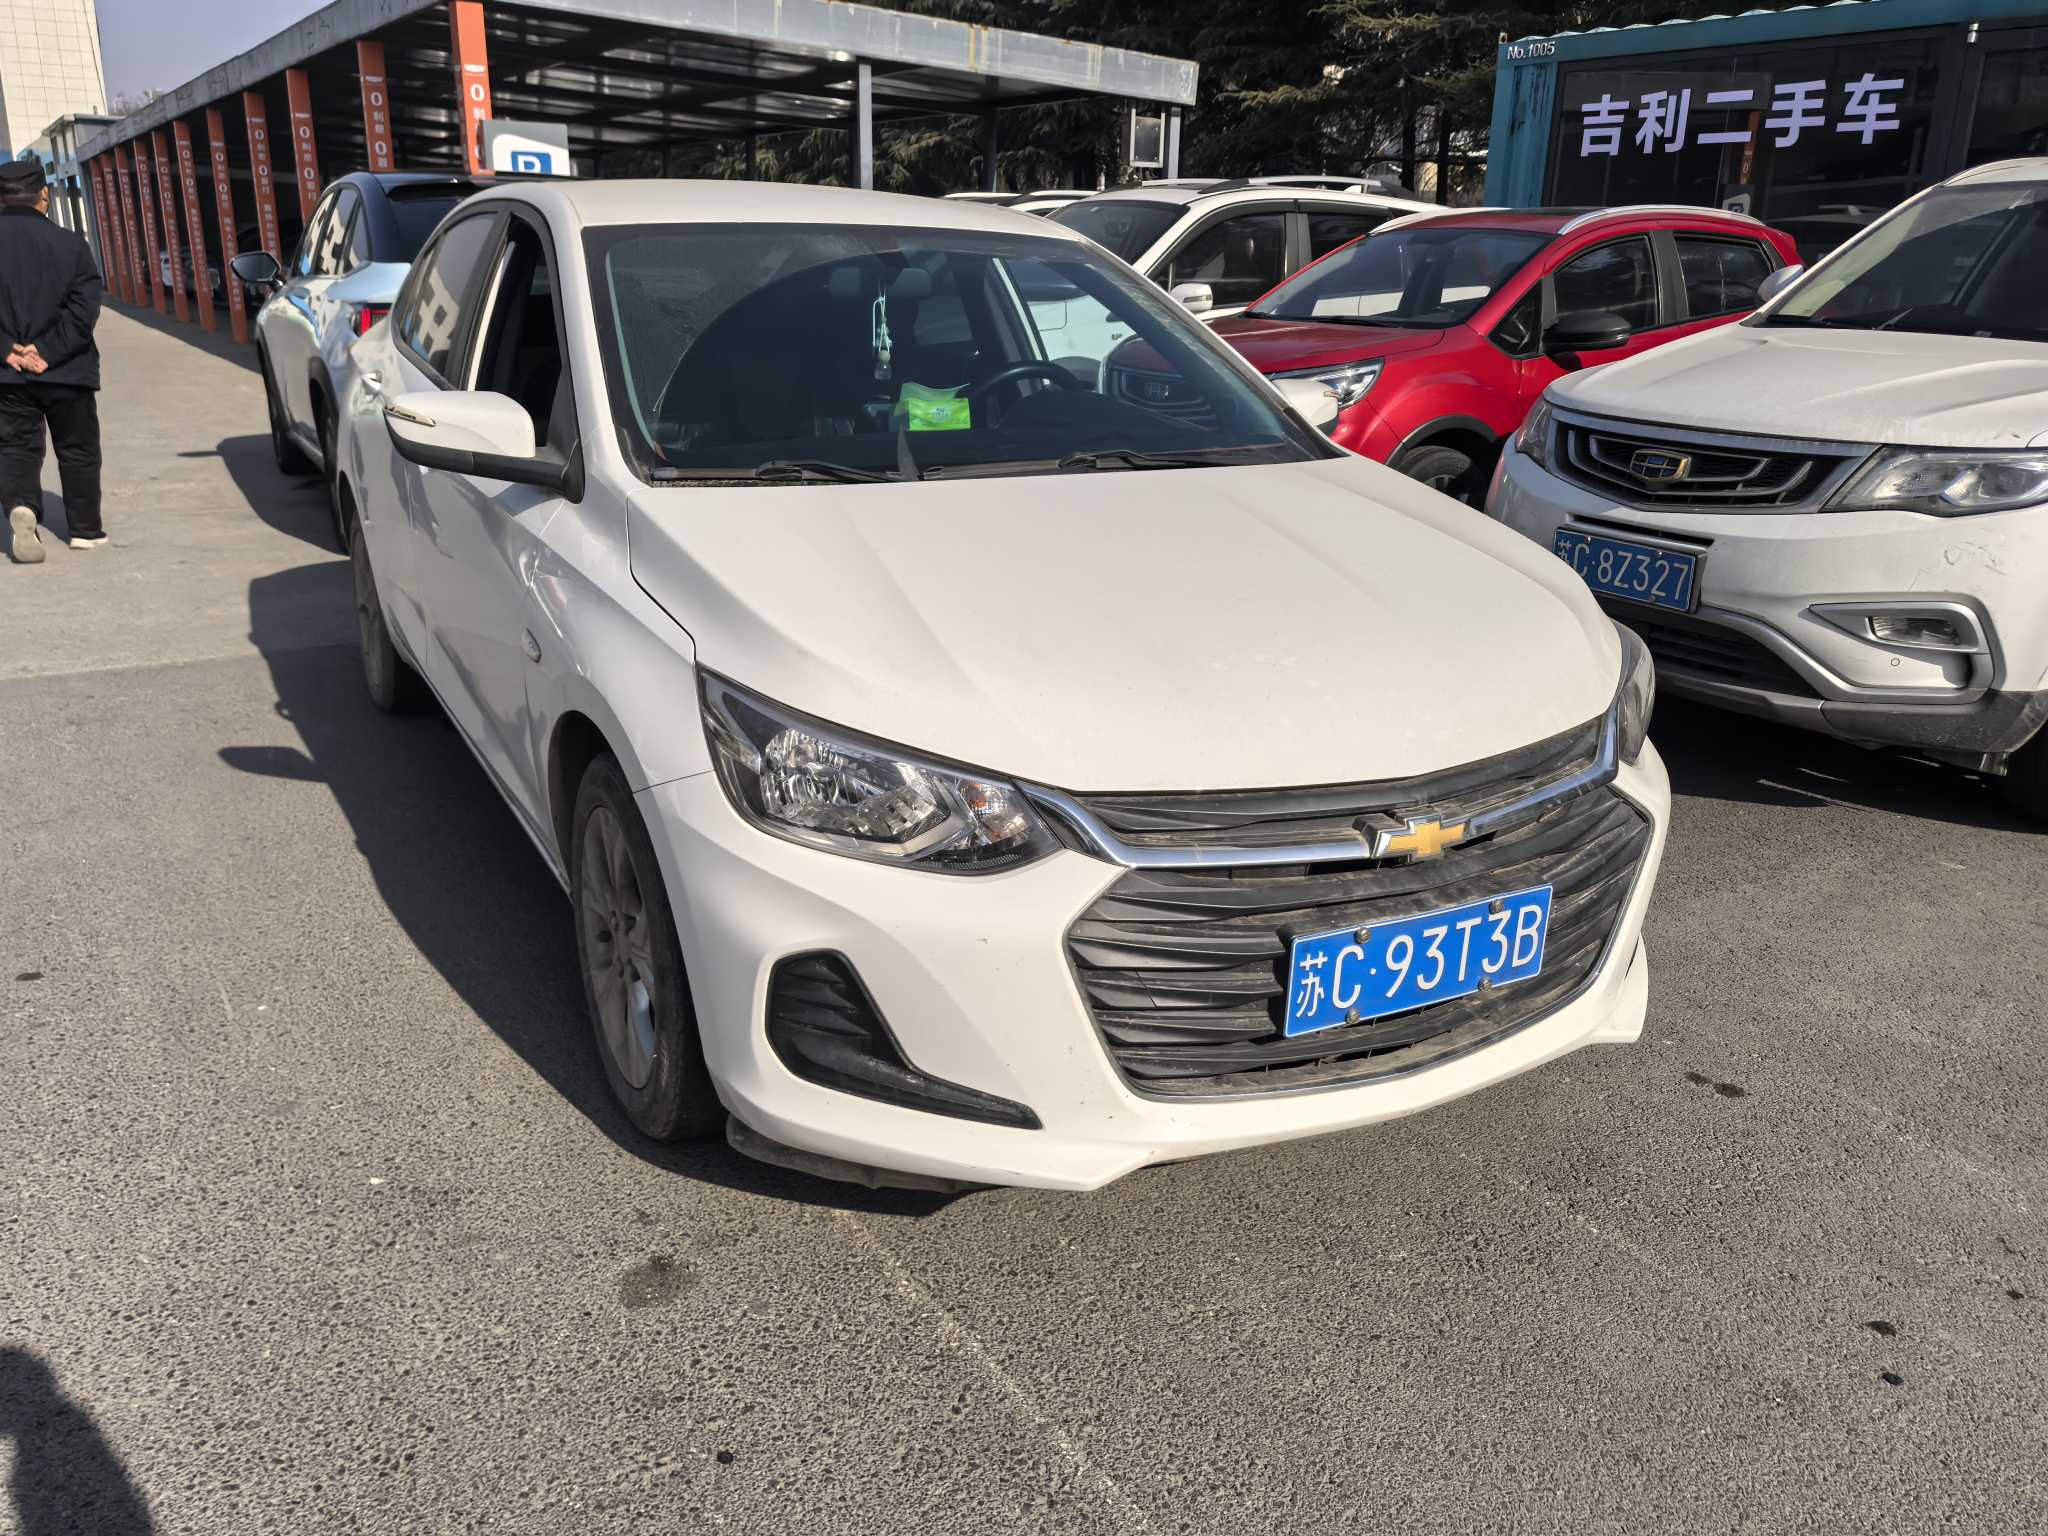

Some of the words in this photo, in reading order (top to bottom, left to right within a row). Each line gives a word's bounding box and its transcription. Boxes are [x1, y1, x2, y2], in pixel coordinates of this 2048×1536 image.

[1507, 41, 1556, 60] No.1005
[1580, 72, 1905, 158] 吉利二手车
[1295, 903, 1543, 1020] 苏C·93T3B
